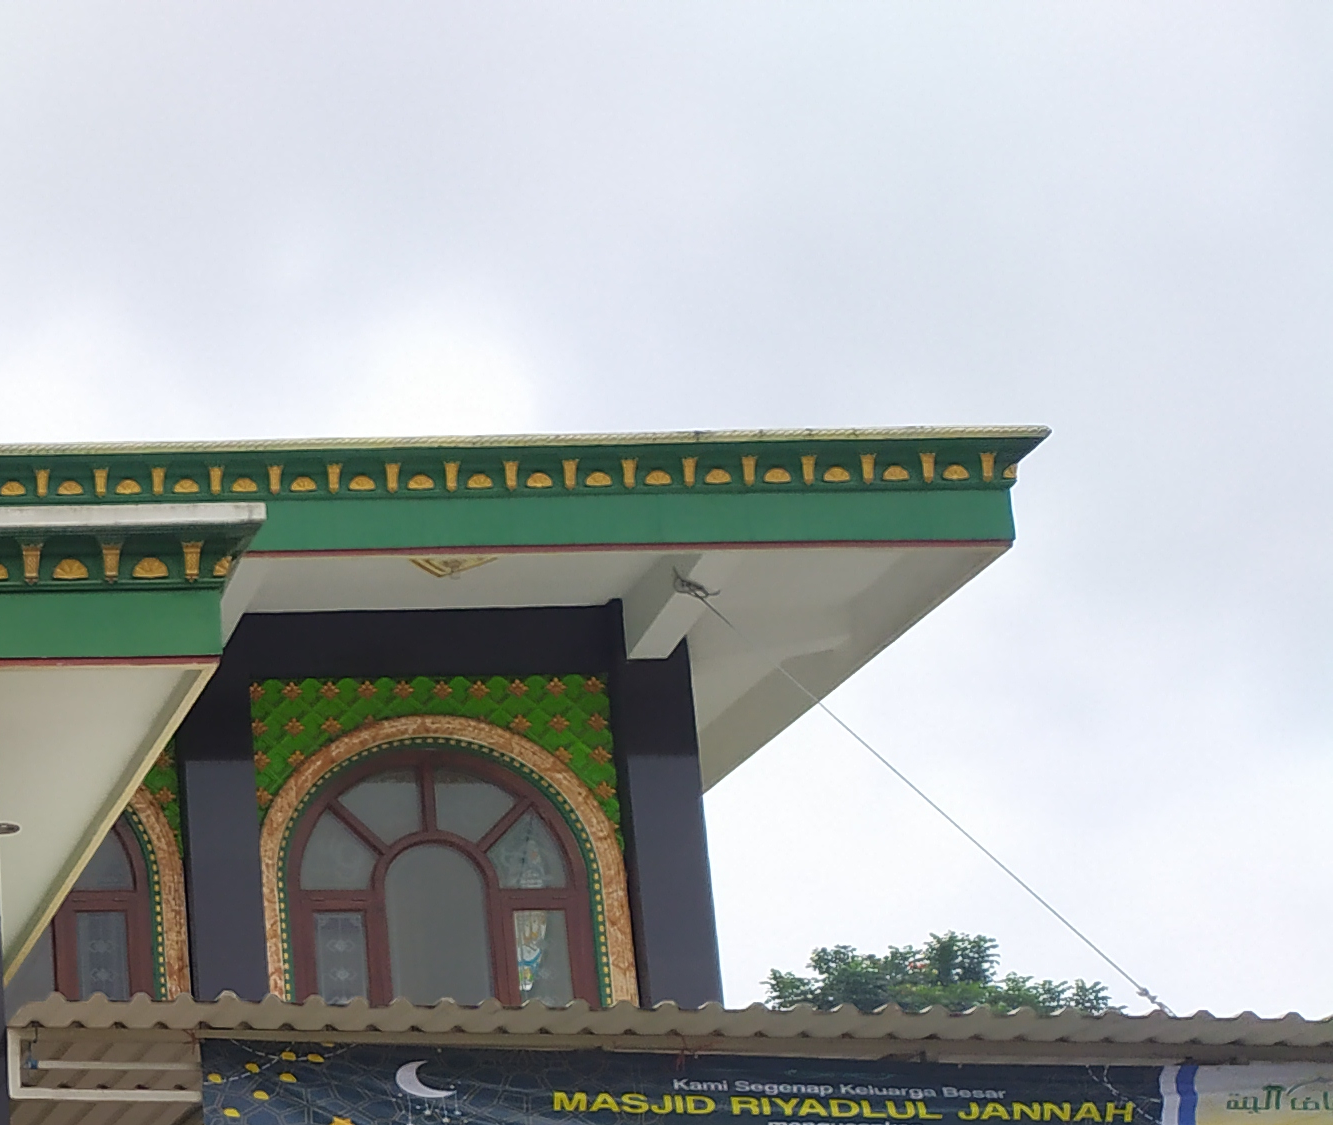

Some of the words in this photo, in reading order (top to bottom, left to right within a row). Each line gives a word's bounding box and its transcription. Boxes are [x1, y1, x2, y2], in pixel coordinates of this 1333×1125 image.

[673, 1078, 728, 1092] Kami
[734, 1080, 832, 1096] Segenap
[840, 1084, 936, 1098] Keluarga
[942, 1086, 1006, 1099] Besar
[552, 1090, 715, 1114] MASJID
[731, 1096, 942, 1119] RIYADLUL
[958, 1101, 1133, 1122] JANNAH
